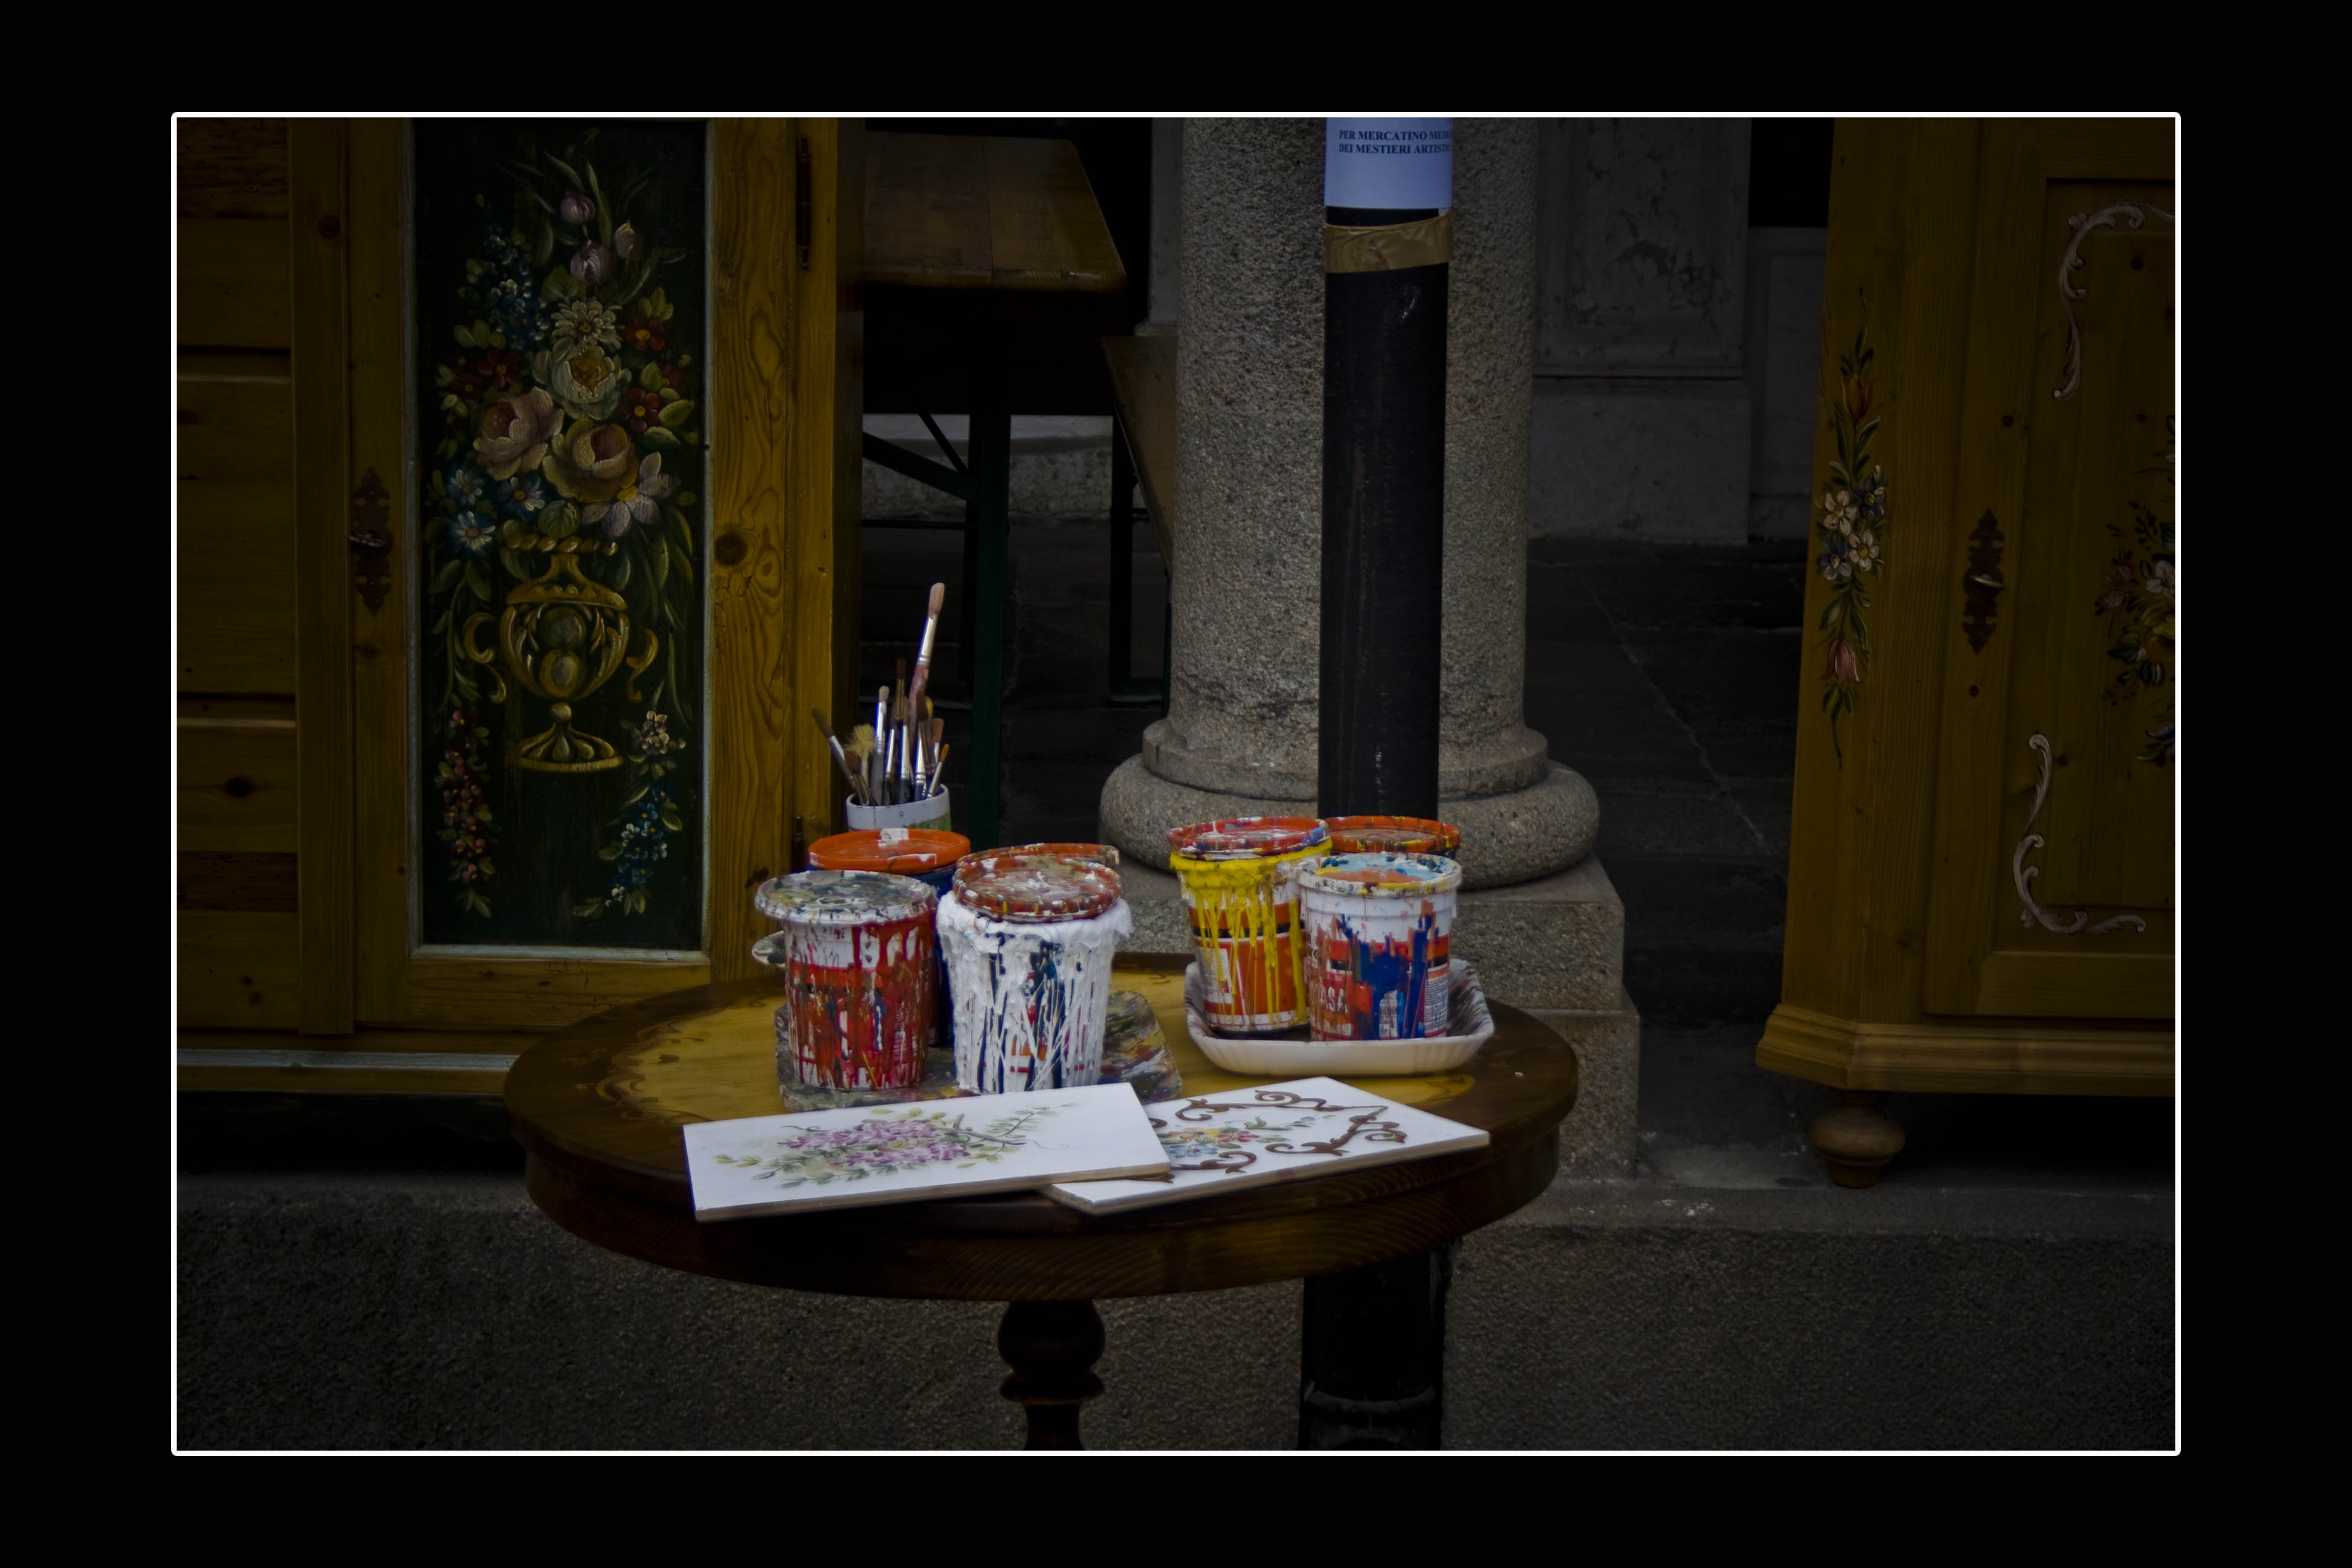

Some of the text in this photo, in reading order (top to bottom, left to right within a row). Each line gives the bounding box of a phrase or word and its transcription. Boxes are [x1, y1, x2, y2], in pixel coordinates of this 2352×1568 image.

[1339, 130, 1355, 140] PER
[1358, 131, 1427, 140] MERCATINO
[1339, 143, 1353, 152] DEI
[1356, 144, 1411, 154] MESTIERI
